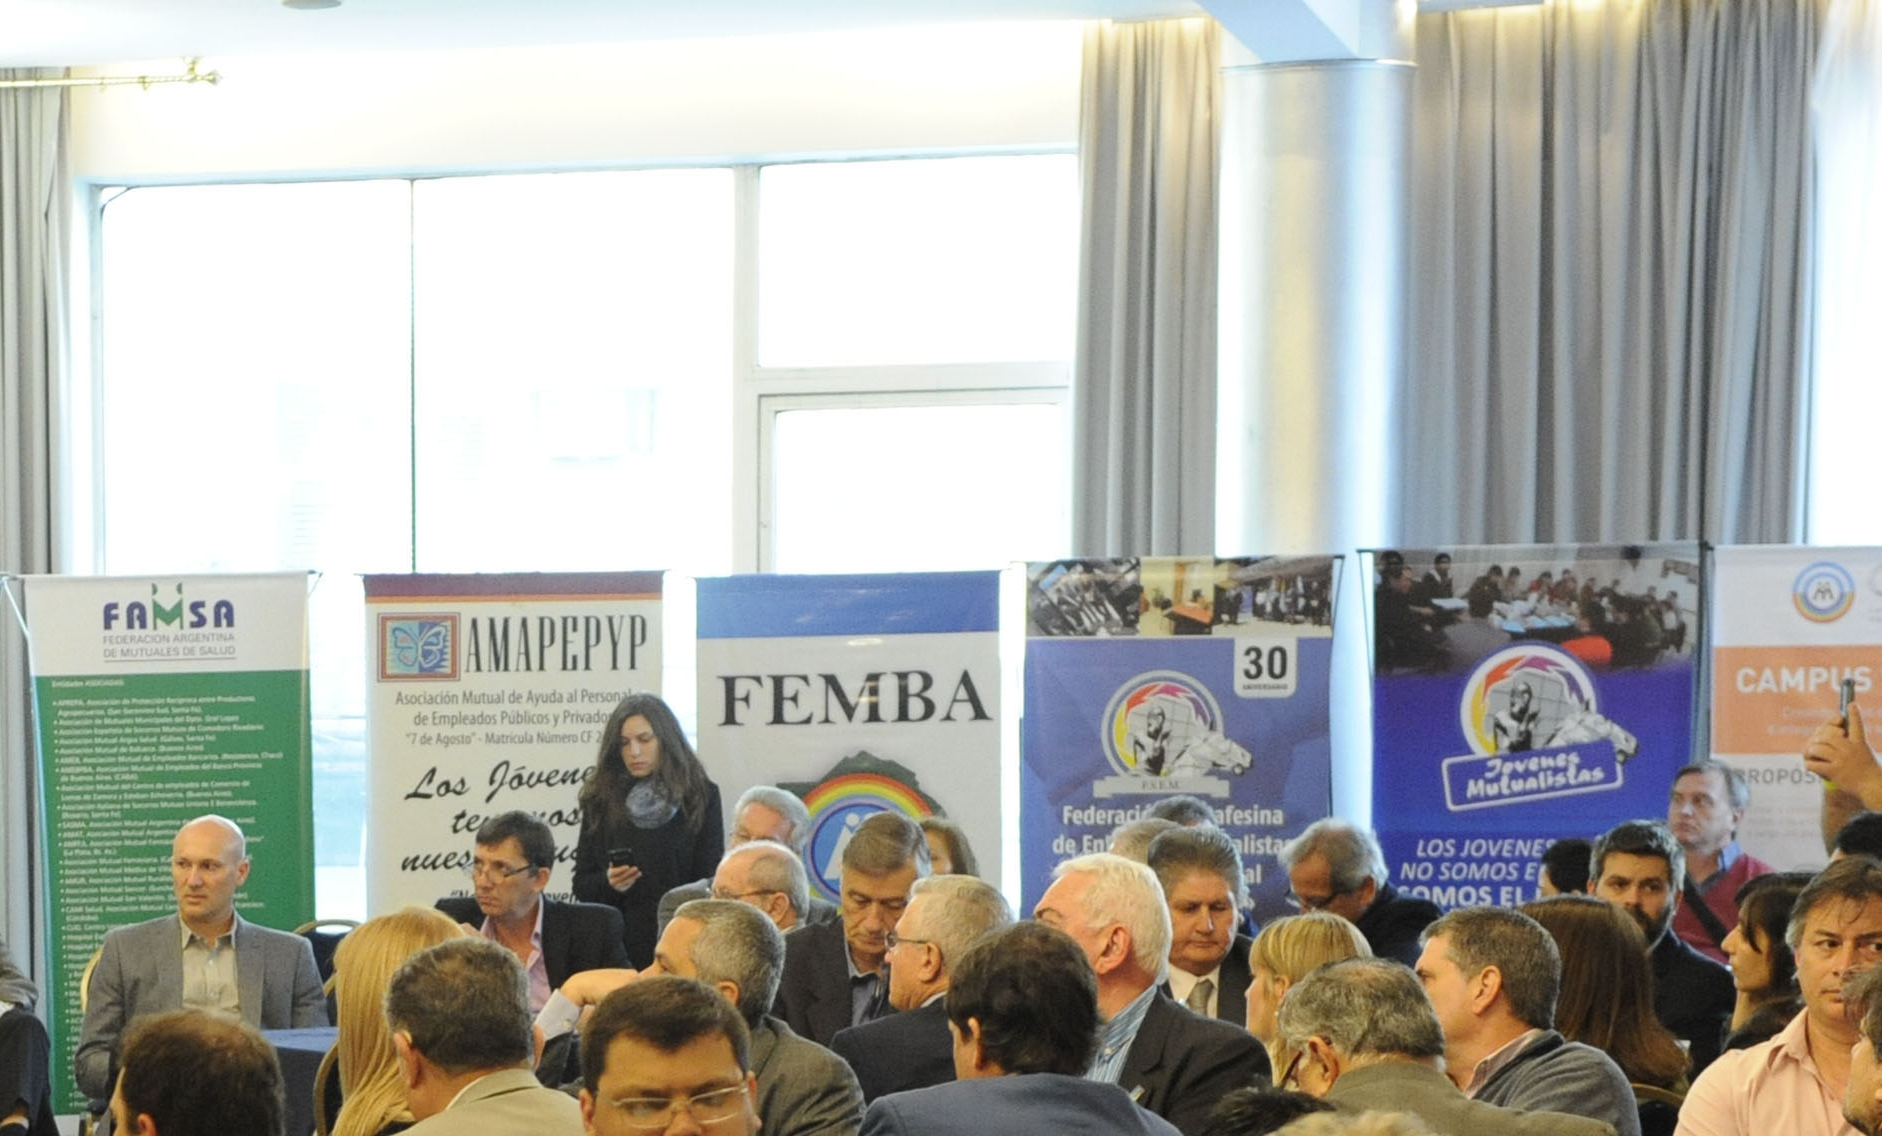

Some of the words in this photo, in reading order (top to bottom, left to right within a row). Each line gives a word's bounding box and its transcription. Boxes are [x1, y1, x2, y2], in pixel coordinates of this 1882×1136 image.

[103, 594, 235, 631] FAMSA
[173, 632, 235, 643] ARGENTINA
[465, 613, 648, 673] AMAPEPYP
[103, 647, 117, 658] DE
[120, 646, 180, 657] MUTUALES
[183, 646, 196, 656] DE
[199, 645, 236, 656] SALUD
[1243, 645, 1288, 680] 30
[1735, 665, 1873, 694] CAMPUS
[396, 690, 459, 705] Asociación
[462, 689, 505, 704] Mutual
[508, 689, 523, 704] de
[528, 689, 563, 708] Ayuda
[566, 689, 577, 703] al
[580, 688, 632, 704] Personal
[716, 669, 994, 727] FEMBA
[414, 711, 428, 726] de
[432, 710, 497, 728] Empleados
[500, 709, 549, 726] Públicos
[552, 713, 560, 728] y
[563, 709, 613, 725] Privado
[420, 732, 433, 745] de
[484, 731, 534, 745] Matrícula
[536, 730, 578, 744] Número
[580, 730, 594, 744] CF
[404, 766, 470, 801] Los
[485, 759, 598, 804] Jóvene
[1466, 766, 1606, 801] Mutualistas
[1052, 834, 1075, 855] de
[1416, 838, 1456, 858] LOS
[1400, 862, 1434, 881] NO
[1438, 861, 1519, 881] SOMOS
